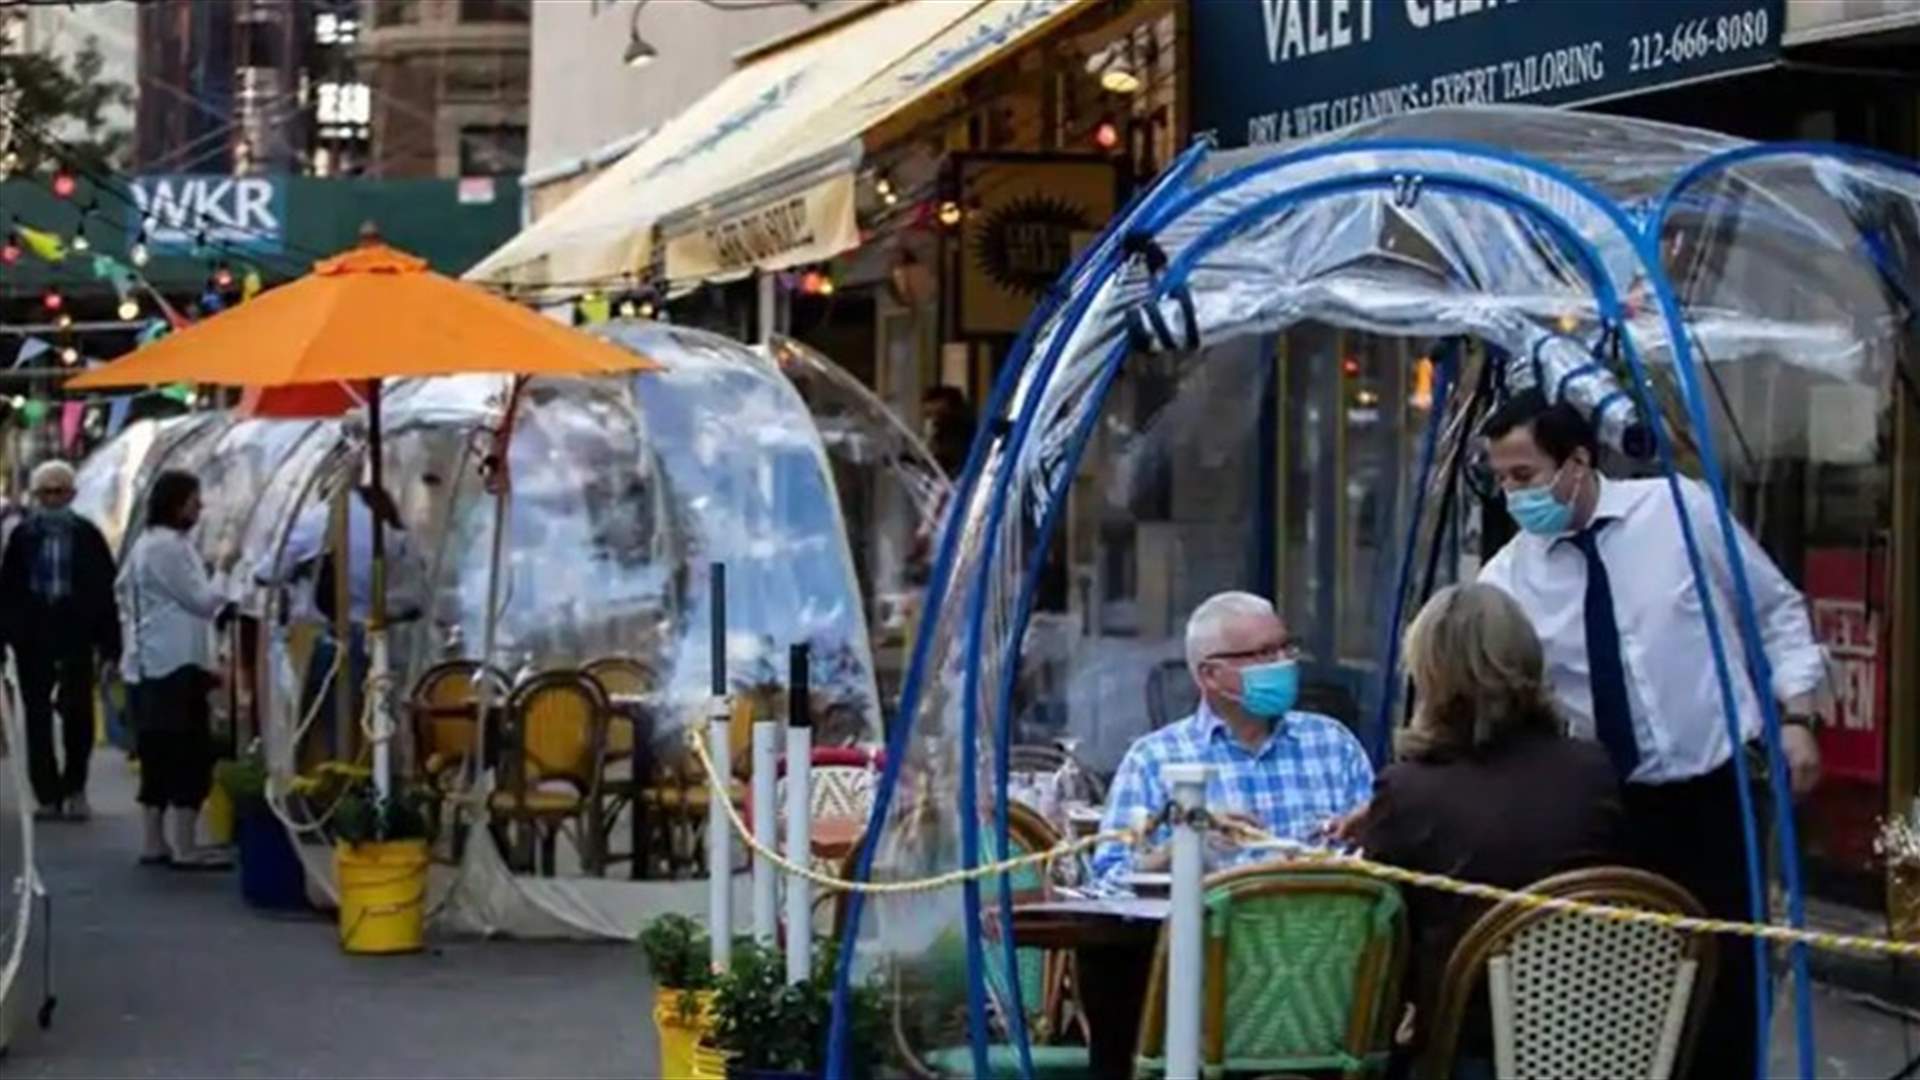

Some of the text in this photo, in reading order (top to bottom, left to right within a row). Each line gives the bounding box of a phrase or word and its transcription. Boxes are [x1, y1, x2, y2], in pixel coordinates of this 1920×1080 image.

[1294, 102, 1329, 136] WET
[1431, 66, 1498, 108] EXPERT
[1501, 41, 1604, 99] TAILORING
[1629, 8, 1769, 72] 212-666-8080
[128, 178, 279, 229] WKR
